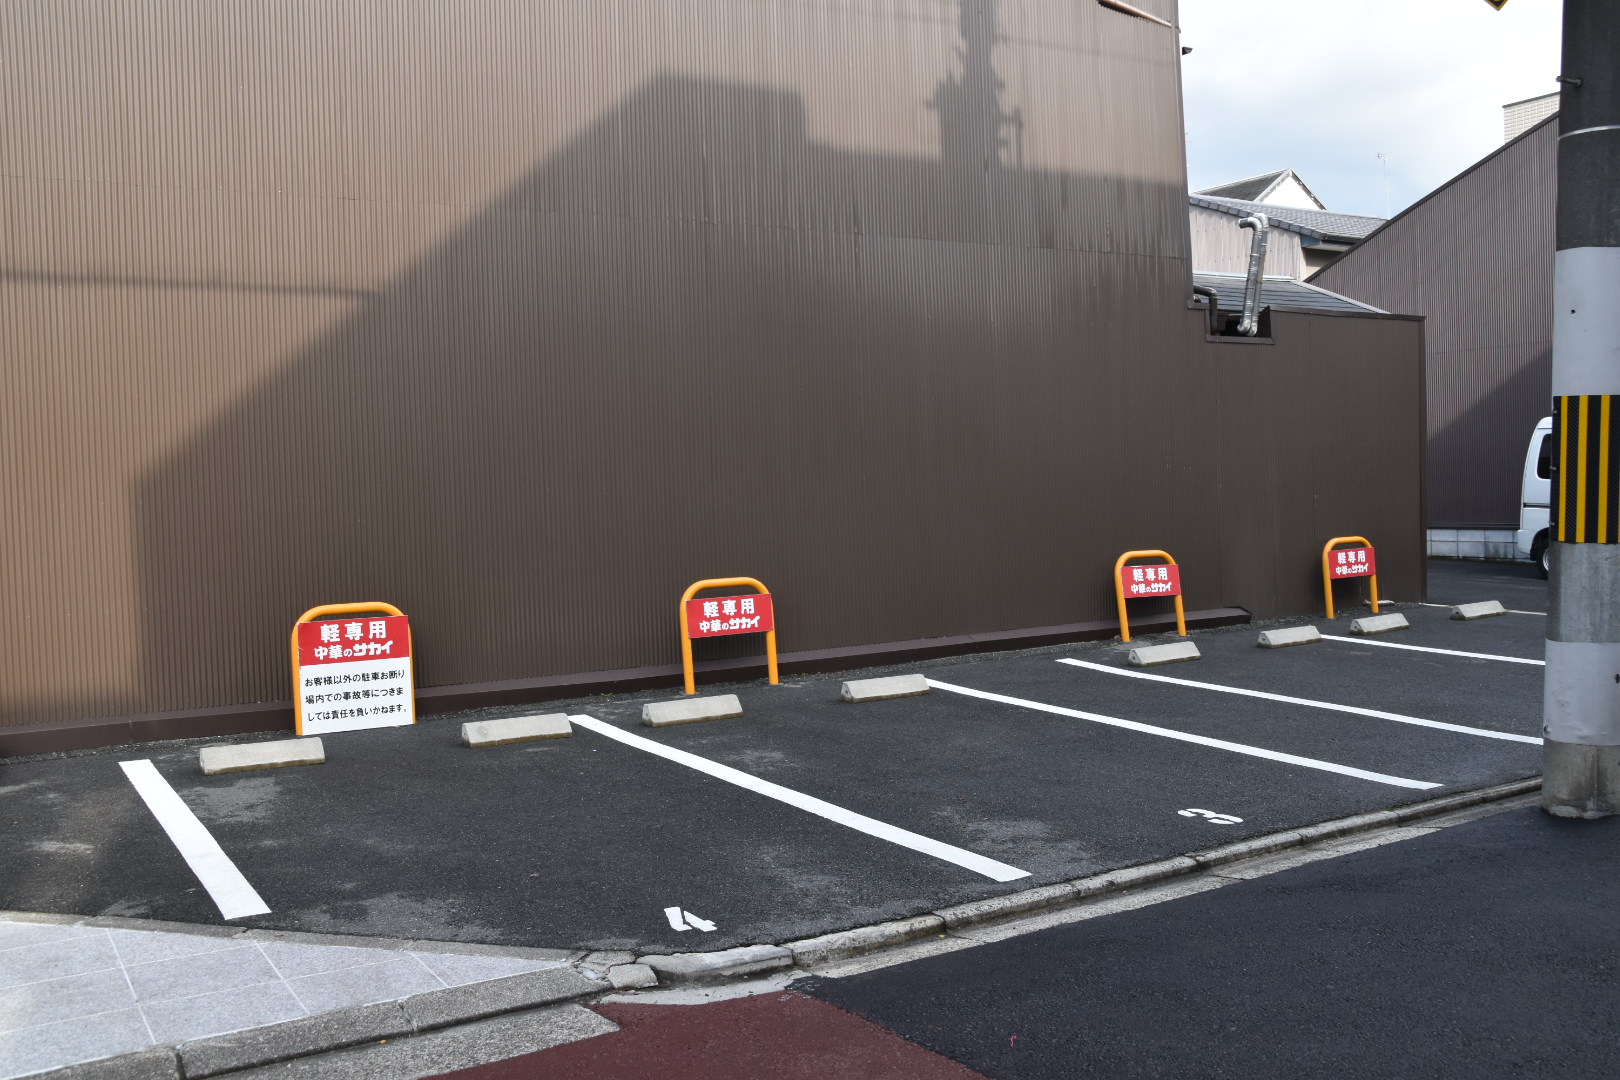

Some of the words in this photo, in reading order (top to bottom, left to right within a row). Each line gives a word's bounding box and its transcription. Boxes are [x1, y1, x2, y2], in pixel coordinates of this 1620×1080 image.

[1337, 550, 1366, 564] 軽専用
[1132, 567, 1168, 582] 軽専用
[1130, 581, 1172, 594] 中華のサカイ
[703, 598, 755, 618] 軽専用
[320, 620, 387, 643] 軽専用
[699, 615, 760, 633] 中華のサカイ
[314, 640, 394, 660] 中華のサカイ
[304, 669, 405, 687] お客様以外の駐車お断り
[305, 687, 404, 704] 場内での事故等につきま
[307, 704, 407, 722] しては責任を負いかねます。
[1177, 808, 1244, 825] 3
[663, 906, 718, 932] 4
